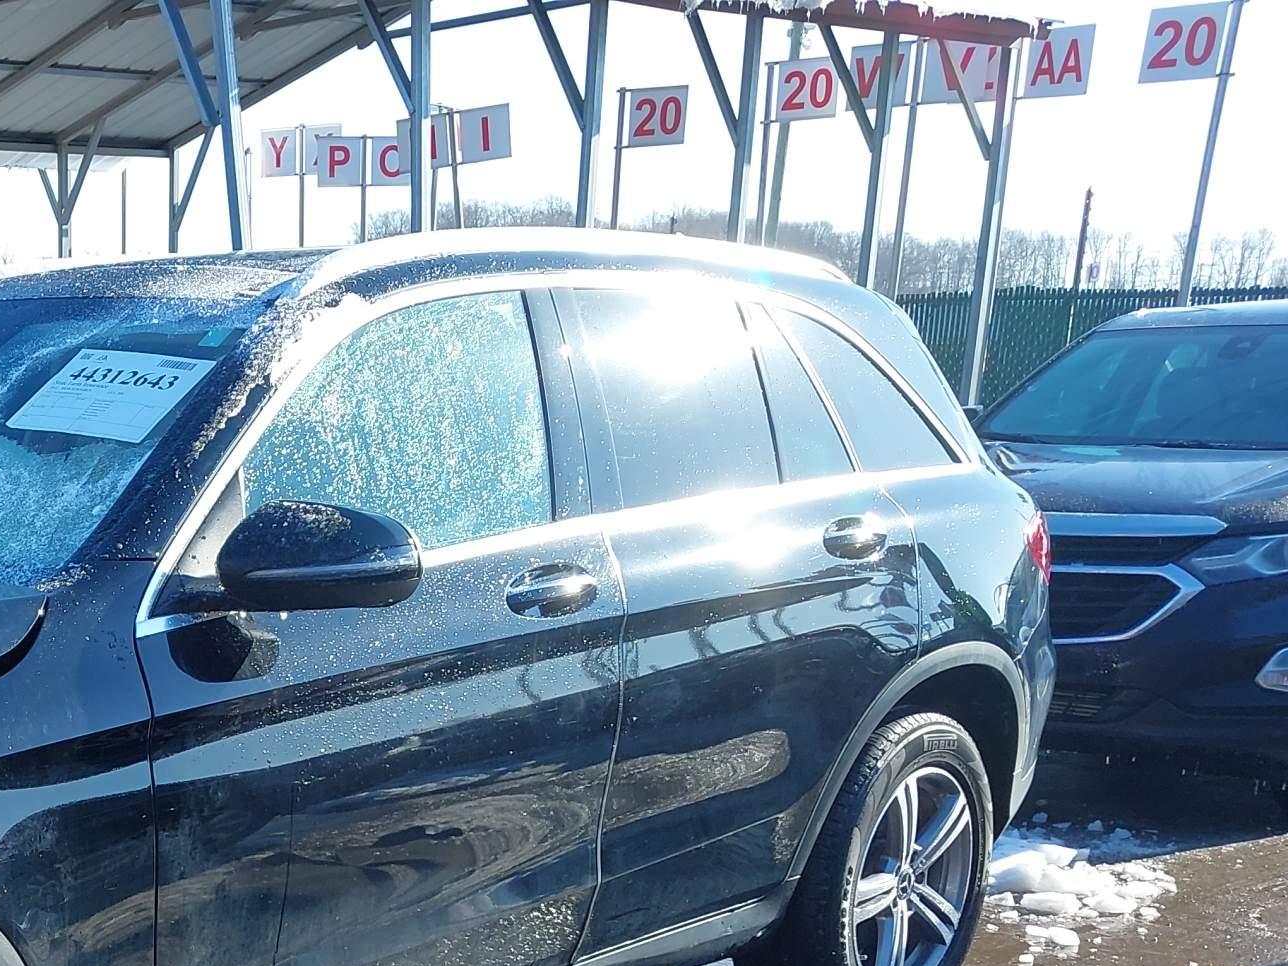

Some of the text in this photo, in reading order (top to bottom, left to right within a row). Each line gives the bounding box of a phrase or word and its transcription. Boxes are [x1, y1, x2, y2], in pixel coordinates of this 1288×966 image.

[1030, 38, 1081, 86] AA
[1147, 16, 1217, 69] 20
[781, 67, 833, 111] 20
[633, 96, 682, 137] 20
[268, 136, 289, 168] Y
[328, 145, 351, 178] P
[70, 366, 179, 389] 44312643
